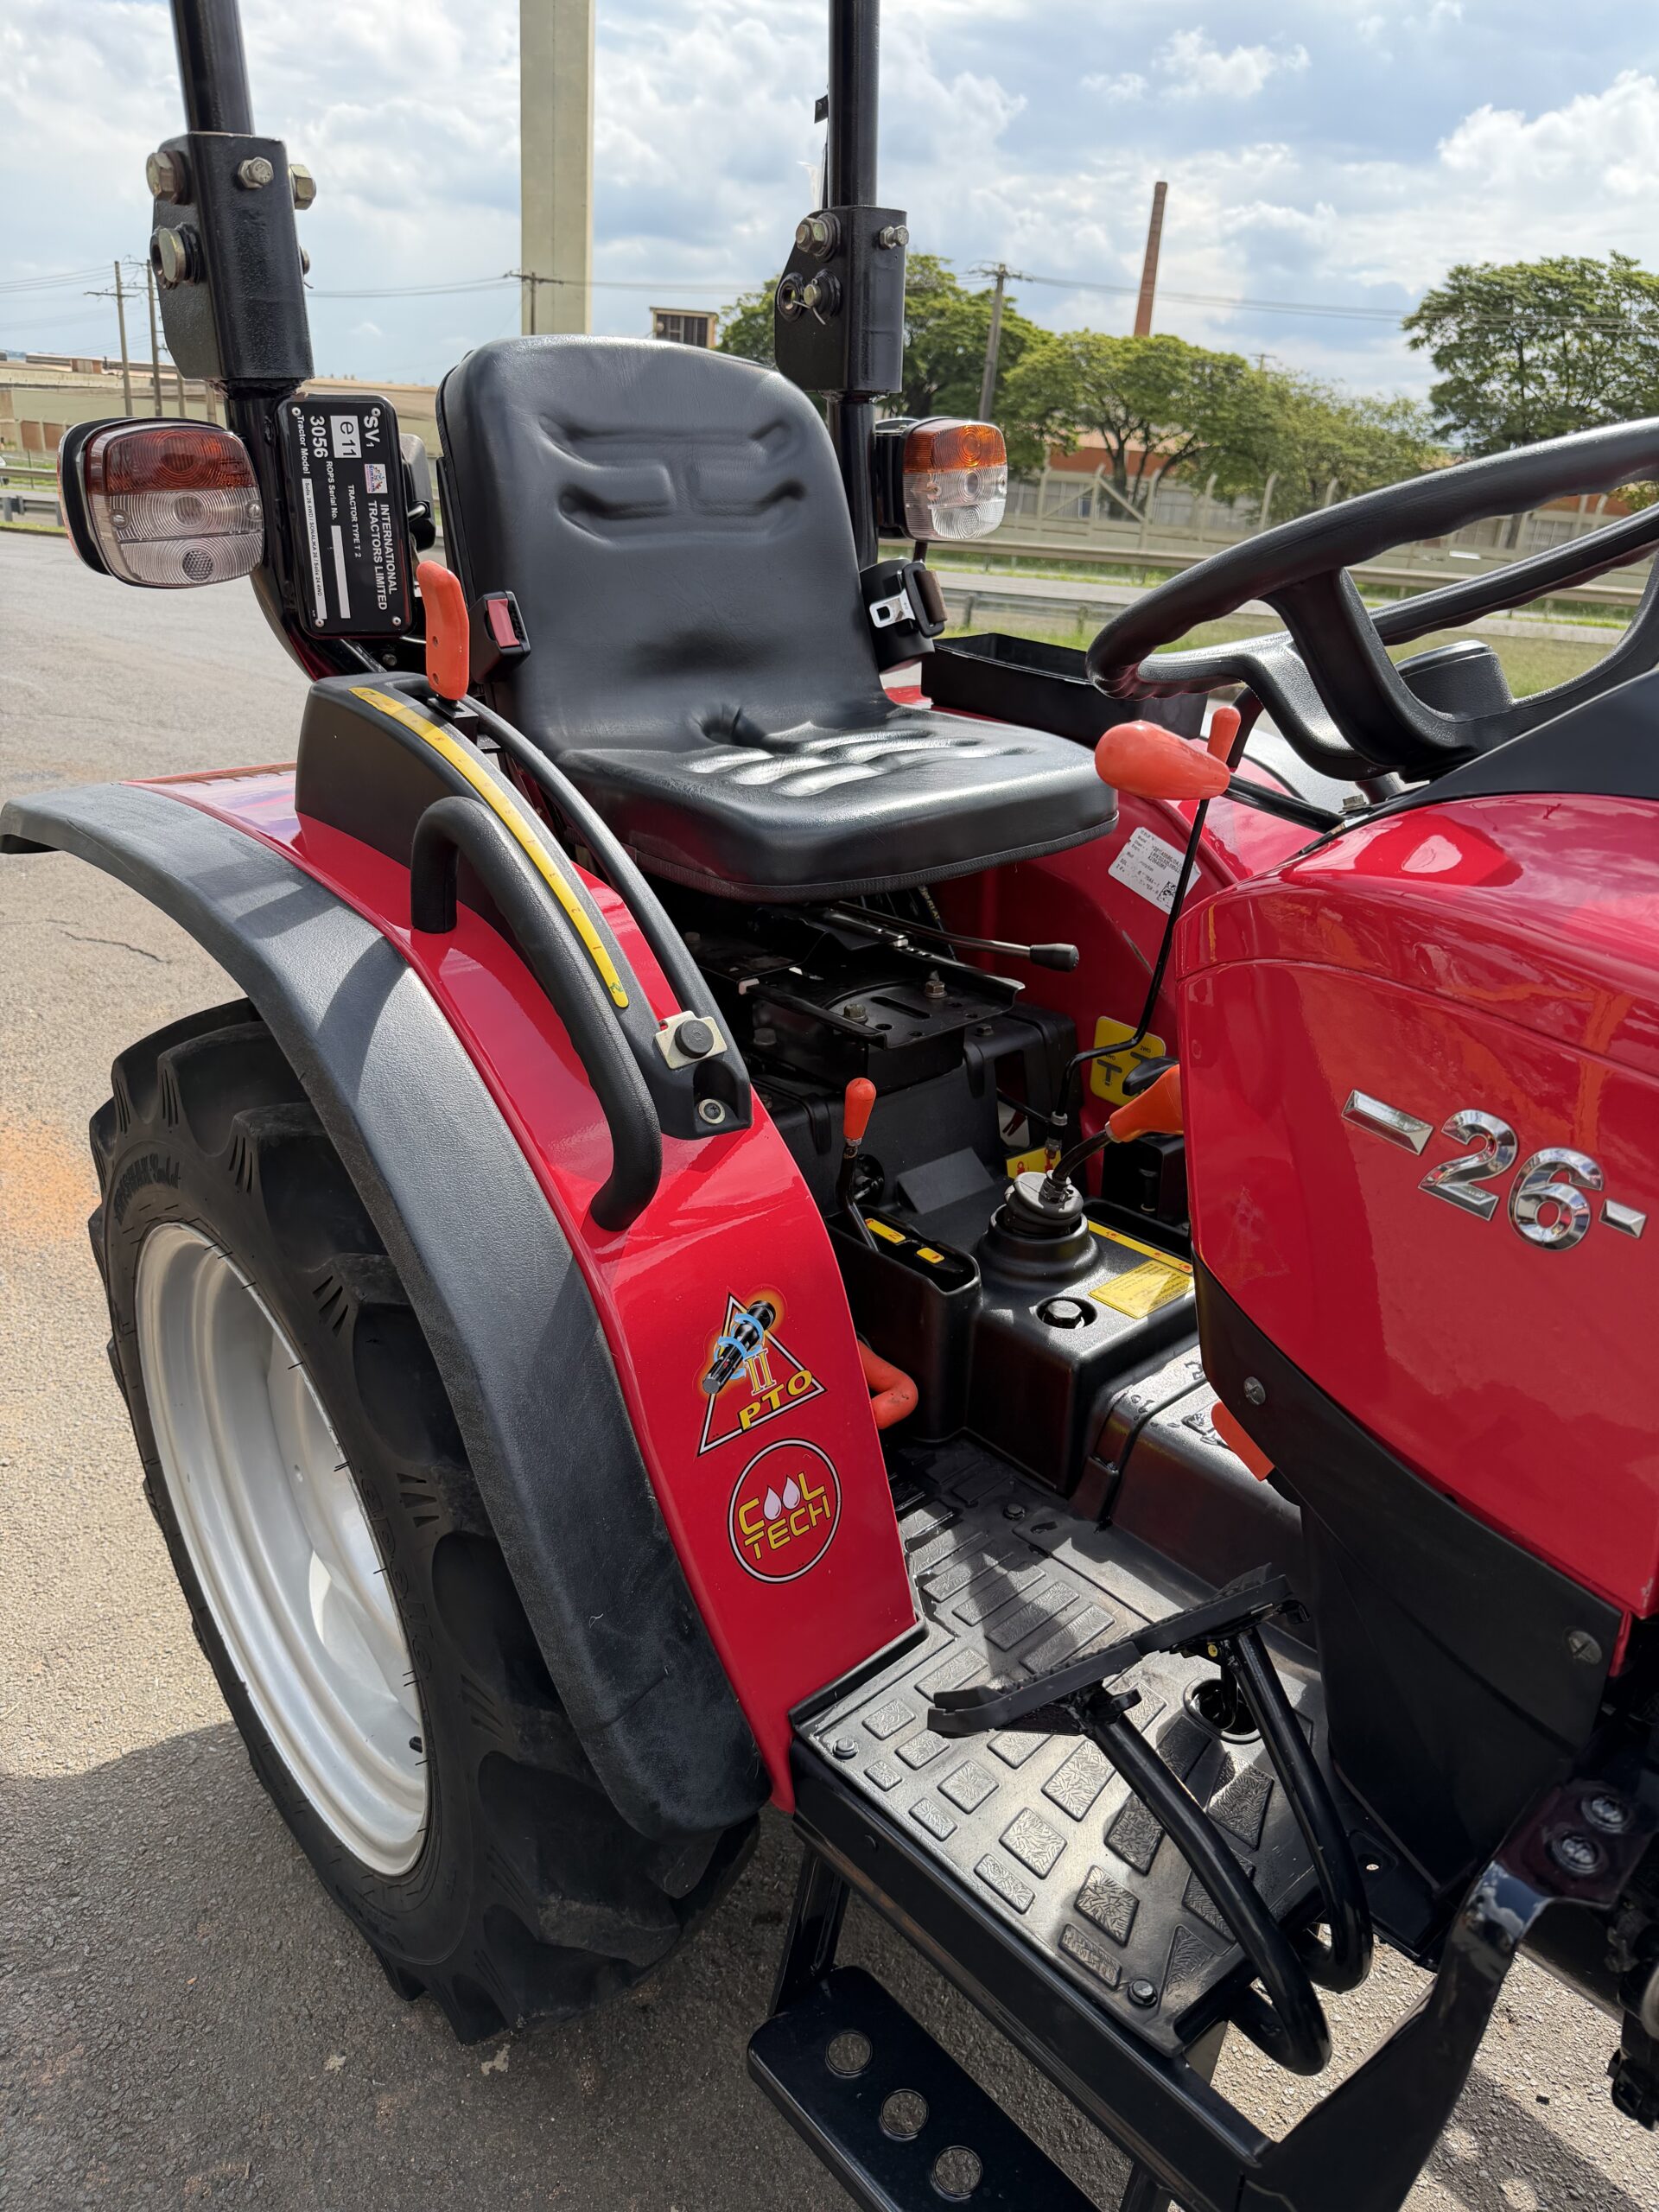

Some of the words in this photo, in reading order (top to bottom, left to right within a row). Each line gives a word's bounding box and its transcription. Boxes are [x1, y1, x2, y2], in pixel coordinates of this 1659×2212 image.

[297, 416, 307, 446] Tractor
[310, 416, 328, 458] 3056
[301, 448, 310, 474] Model
[326, 461, 334, 484] ROPS
[328, 485, 338, 506] Serial
[347, 485, 358, 522] TRACTOR
[352, 524, 360, 543] TYPE
[368, 500, 383, 563] TRACTORS
[380, 504, 397, 594] INTERNATIONAL
[374, 566, 388, 610] LIMITED
[738, 1370, 813, 1432] PTO
[743, 1494, 832, 1561] TECH
